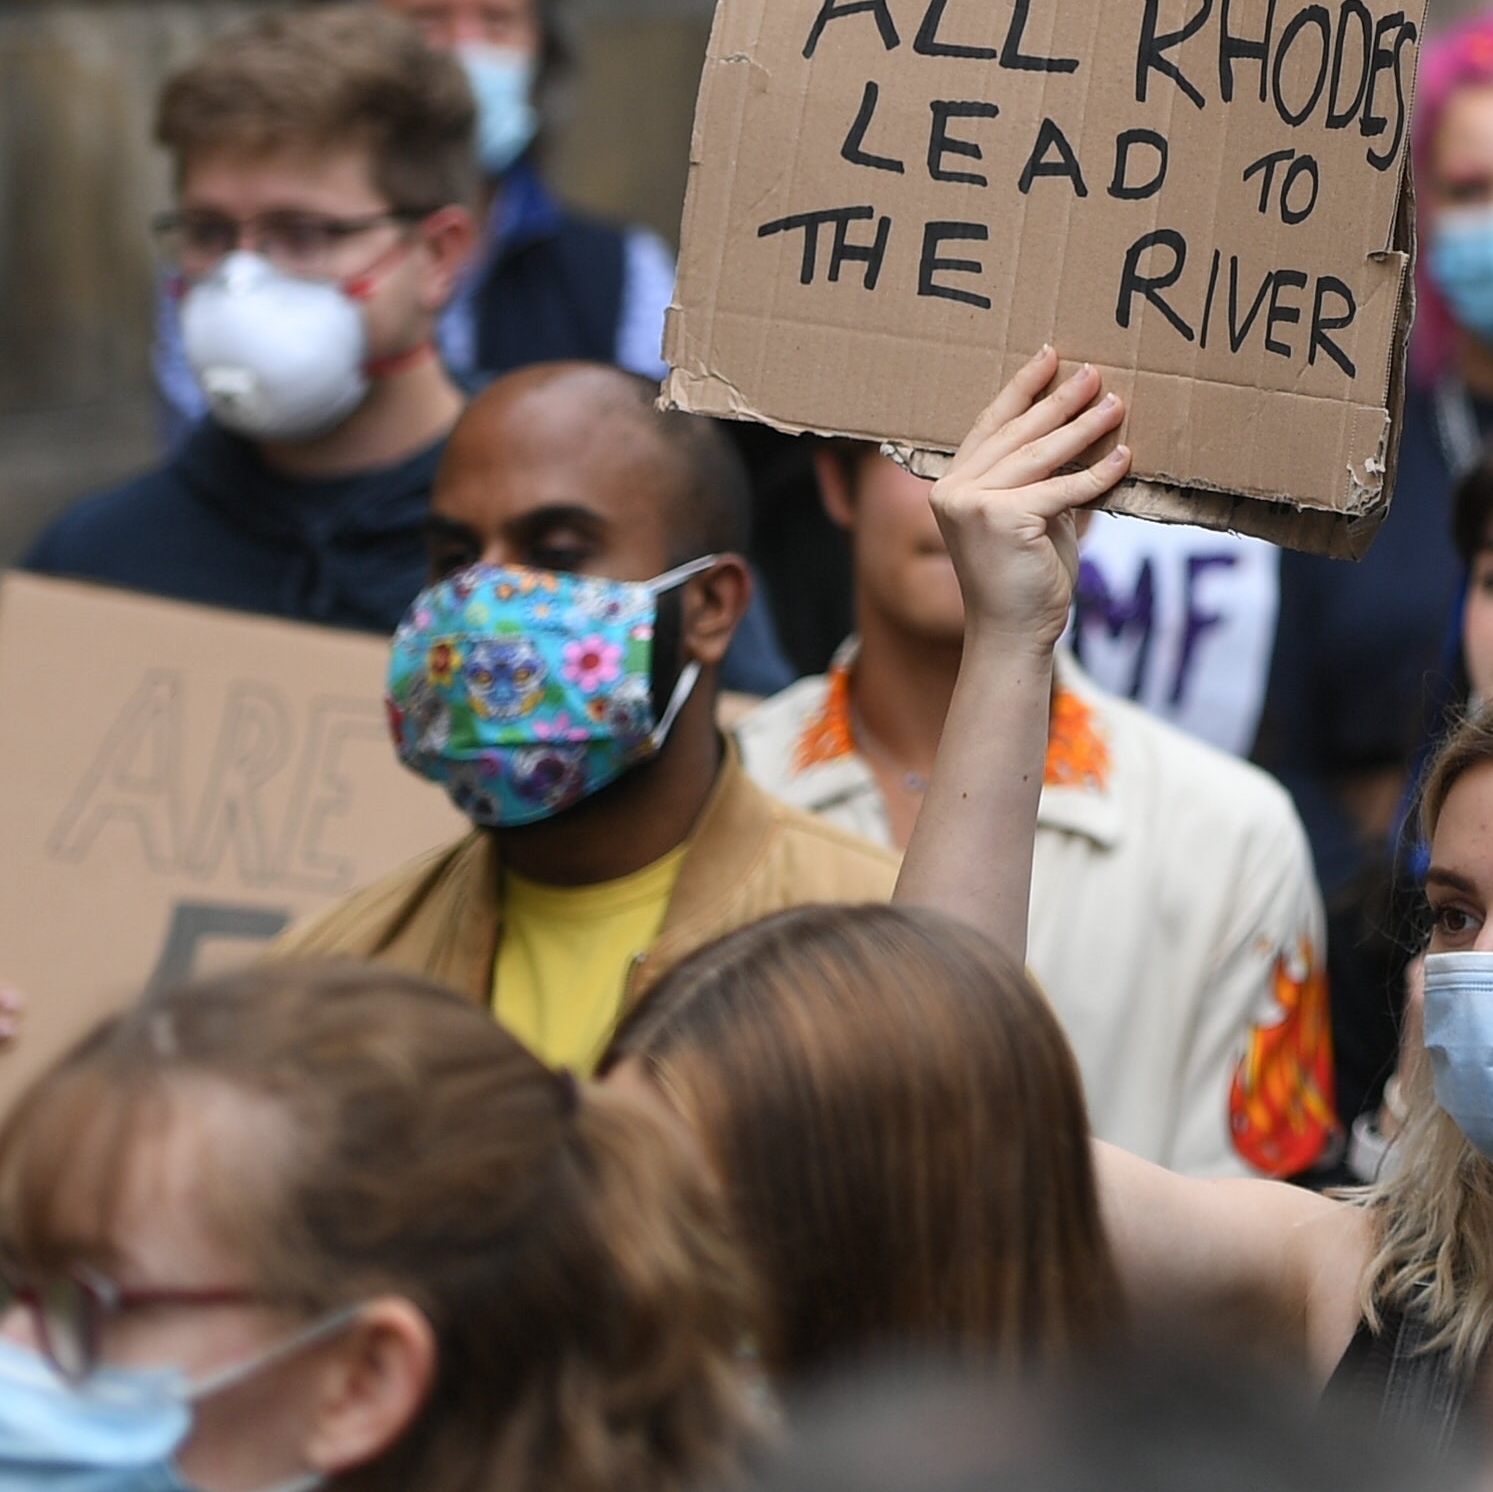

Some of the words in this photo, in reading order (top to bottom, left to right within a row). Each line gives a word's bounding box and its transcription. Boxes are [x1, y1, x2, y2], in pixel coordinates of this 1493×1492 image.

[840, 81, 1169, 200] LEAD
[1243, 147, 1319, 224] TO
[757, 205, 992, 310] THE
[1115, 228, 1356, 379] RIVER
